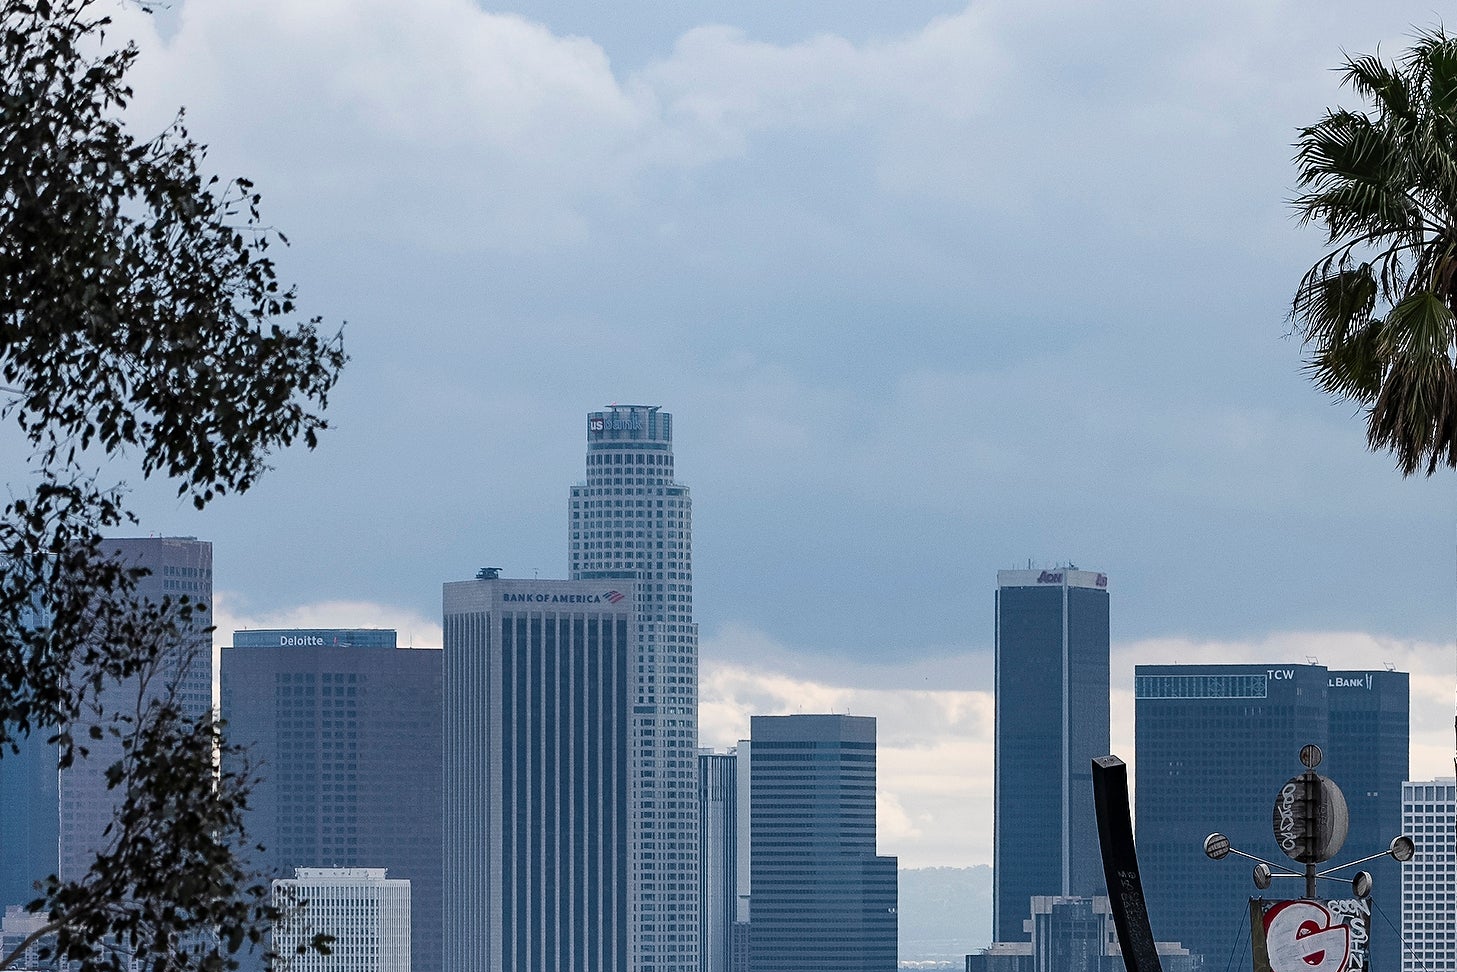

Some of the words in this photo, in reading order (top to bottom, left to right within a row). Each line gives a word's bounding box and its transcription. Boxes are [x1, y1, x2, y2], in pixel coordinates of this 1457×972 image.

[503, 593, 533, 602] BANK
[536, 593, 549, 602] OF
[552, 594, 601, 603] AMERICA
[280, 635, 324, 646] Deloitte
[1267, 670, 1295, 680] TCW
[1335, 677, 1363, 687] BANK
